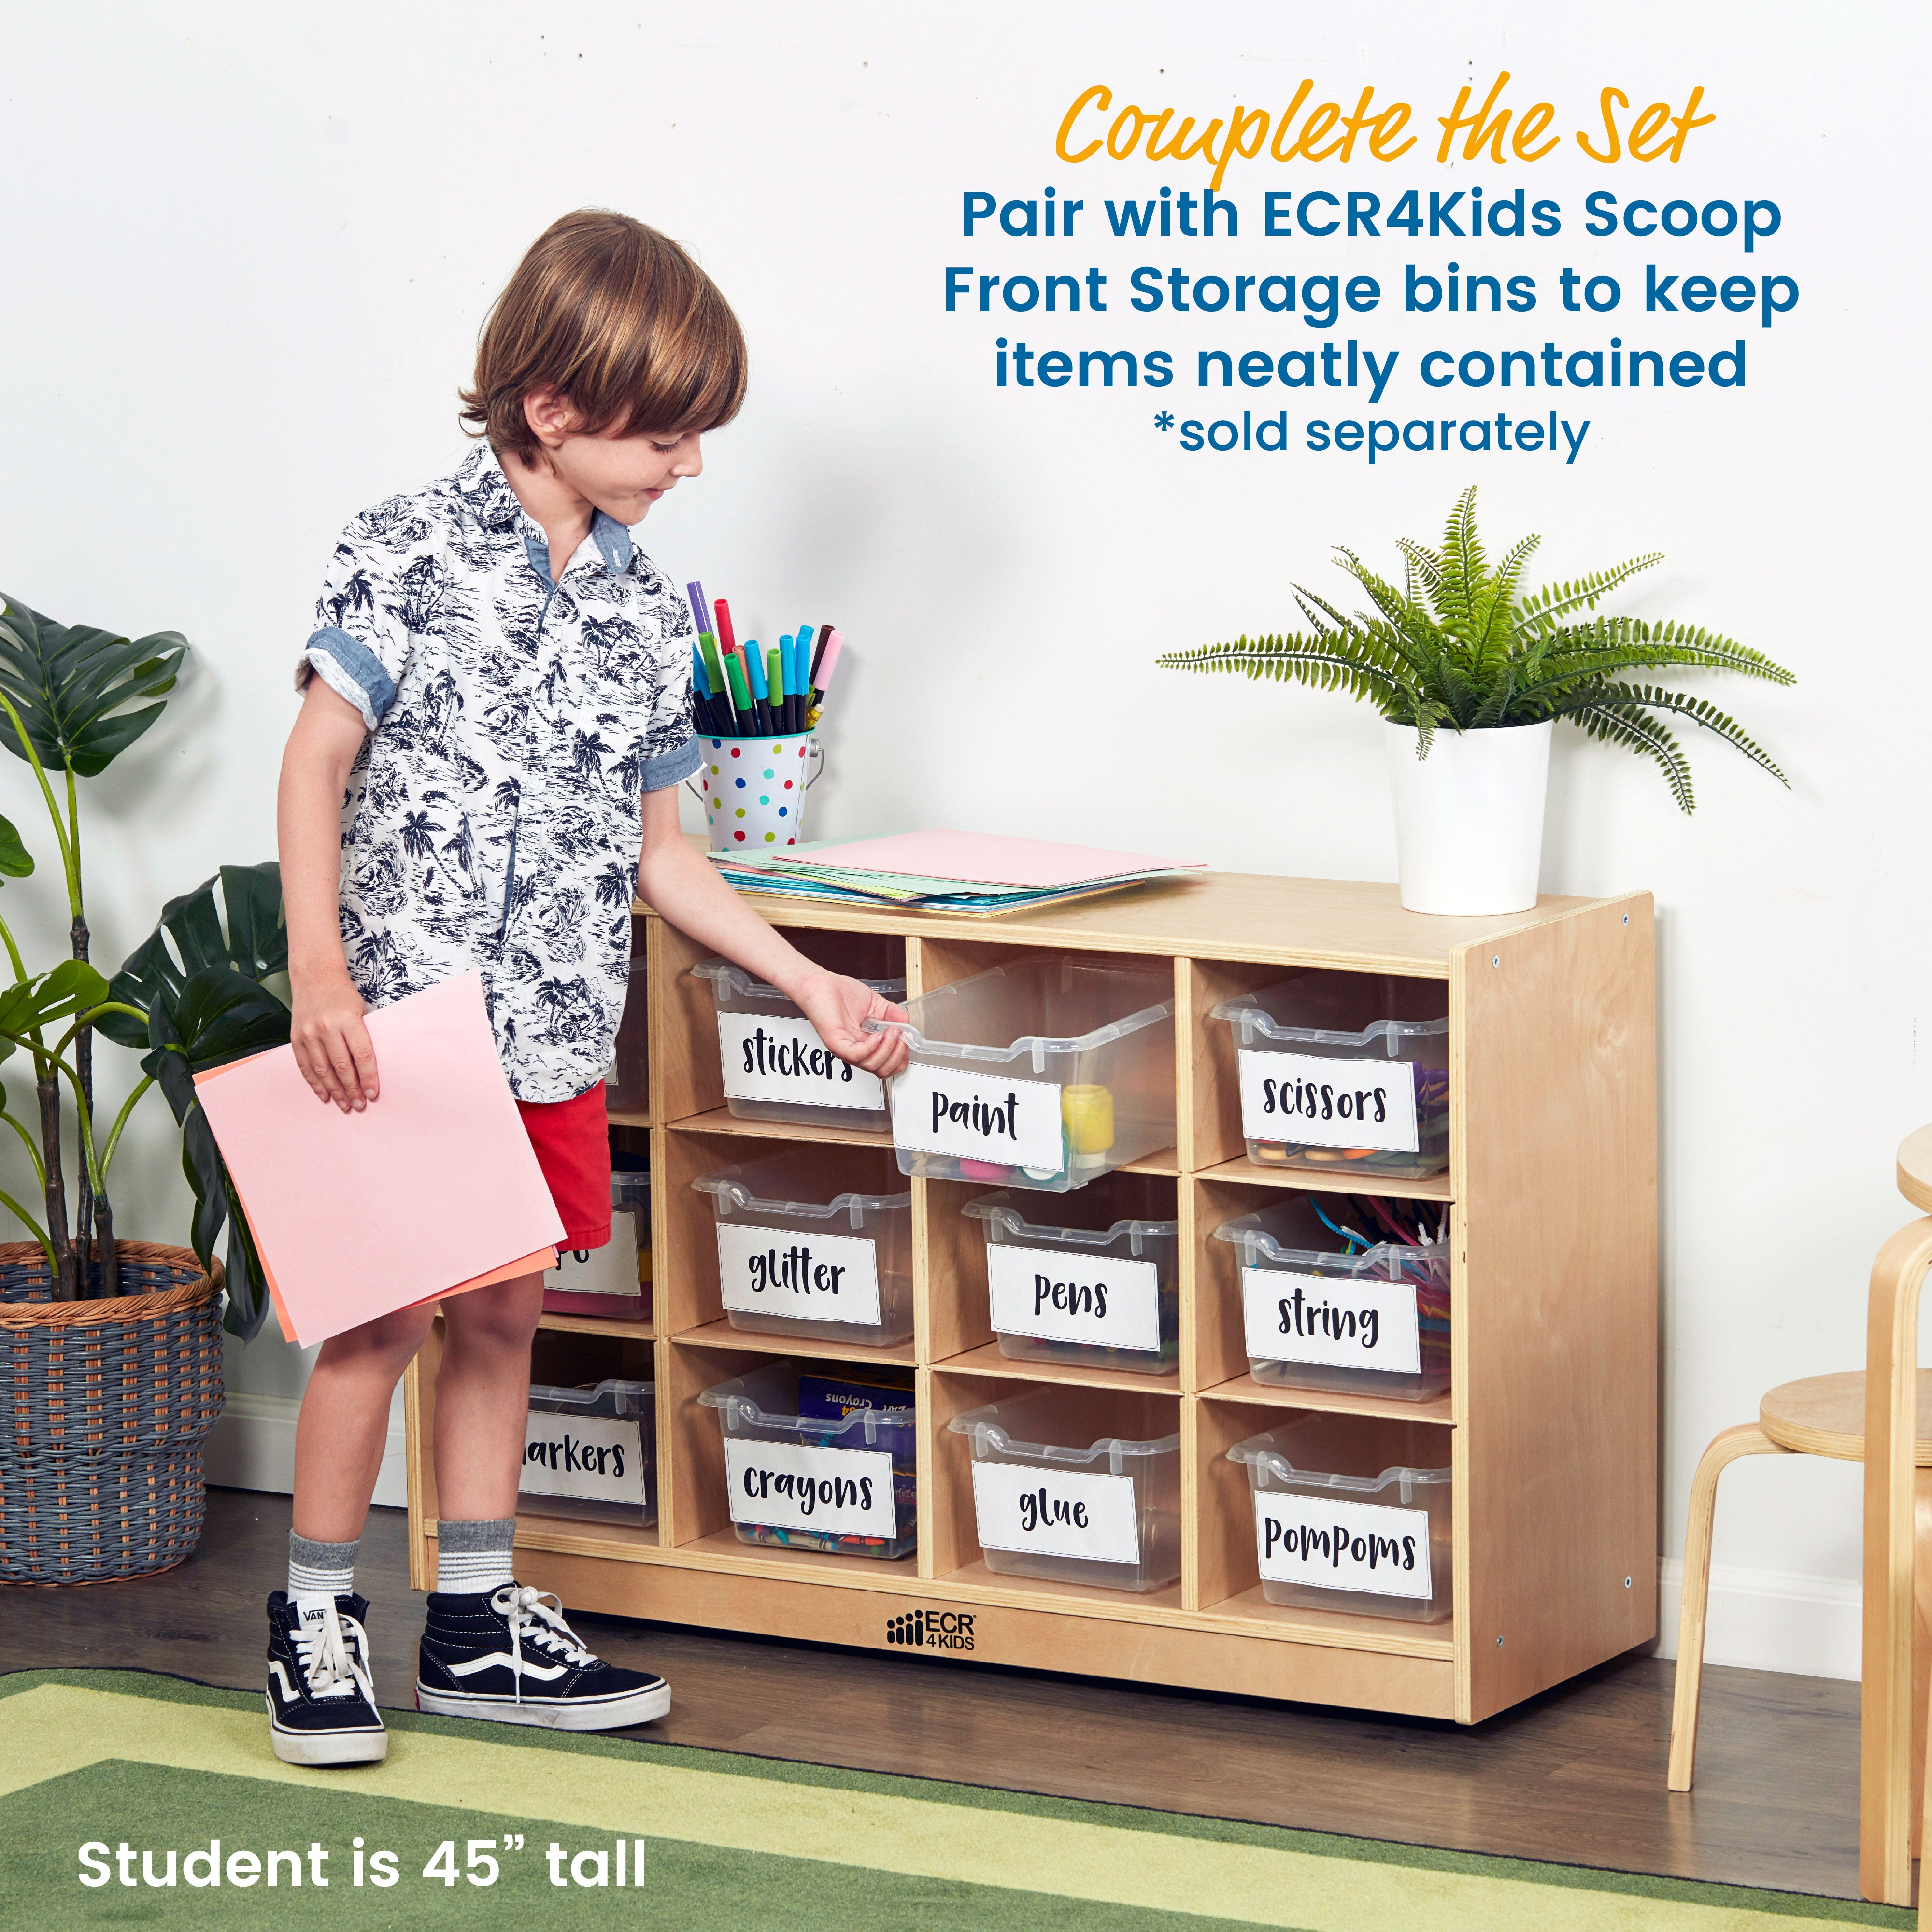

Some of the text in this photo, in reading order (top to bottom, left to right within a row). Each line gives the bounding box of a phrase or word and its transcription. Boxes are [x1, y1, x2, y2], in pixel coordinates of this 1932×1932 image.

[1263, 1077, 1386, 1123] scissors
[748, 1245, 846, 1295] glitter
[1278, 1287, 1379, 1349] string
[826, 1393, 872, 1410] Crayons
[522, 1434, 625, 1478] arkers
[743, 1466, 873, 1516] crayons
[1019, 1487, 1089, 1532] glue
[303, 1609, 325, 1621] VAN
